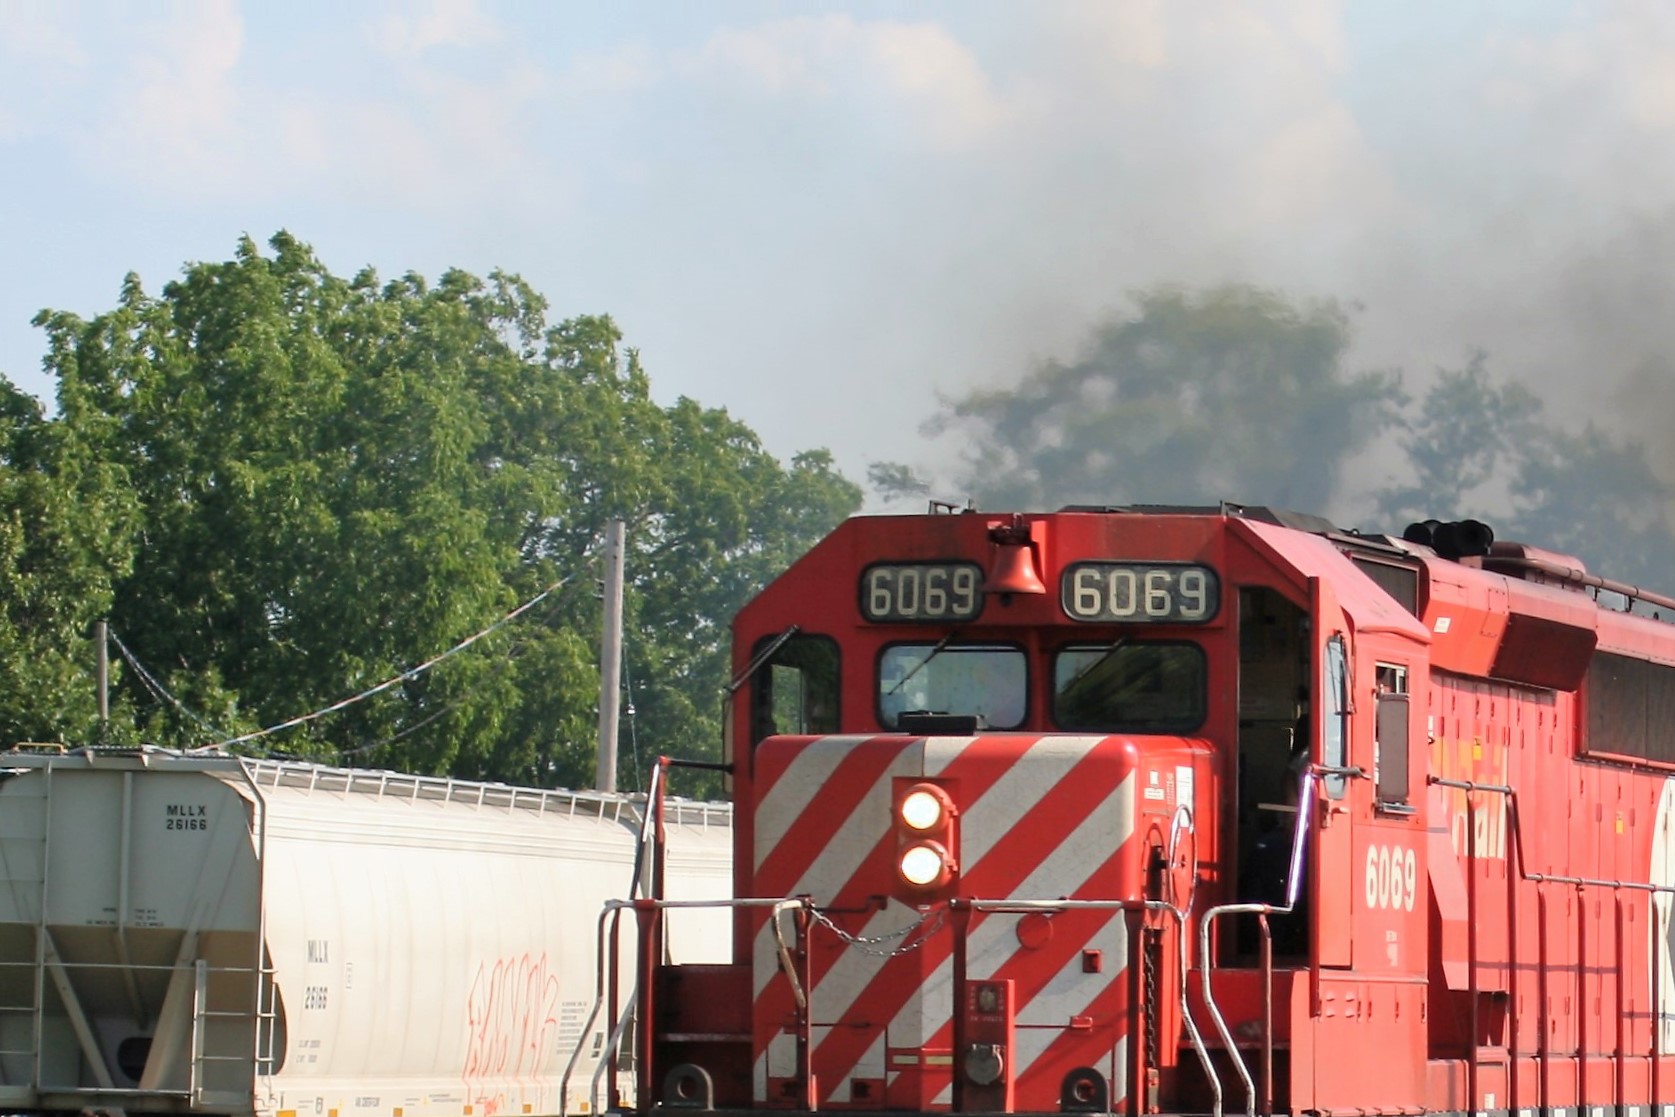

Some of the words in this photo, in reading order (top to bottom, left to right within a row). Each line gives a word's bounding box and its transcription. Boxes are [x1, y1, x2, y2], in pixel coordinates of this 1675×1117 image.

[870, 568, 975, 616] 6069
[1074, 568, 1206, 617] 6069
[166, 805, 206, 817] MLLX
[166, 819, 207, 831] 26166
[1365, 843, 1416, 913] 6069
[307, 939, 329, 963] MLLX
